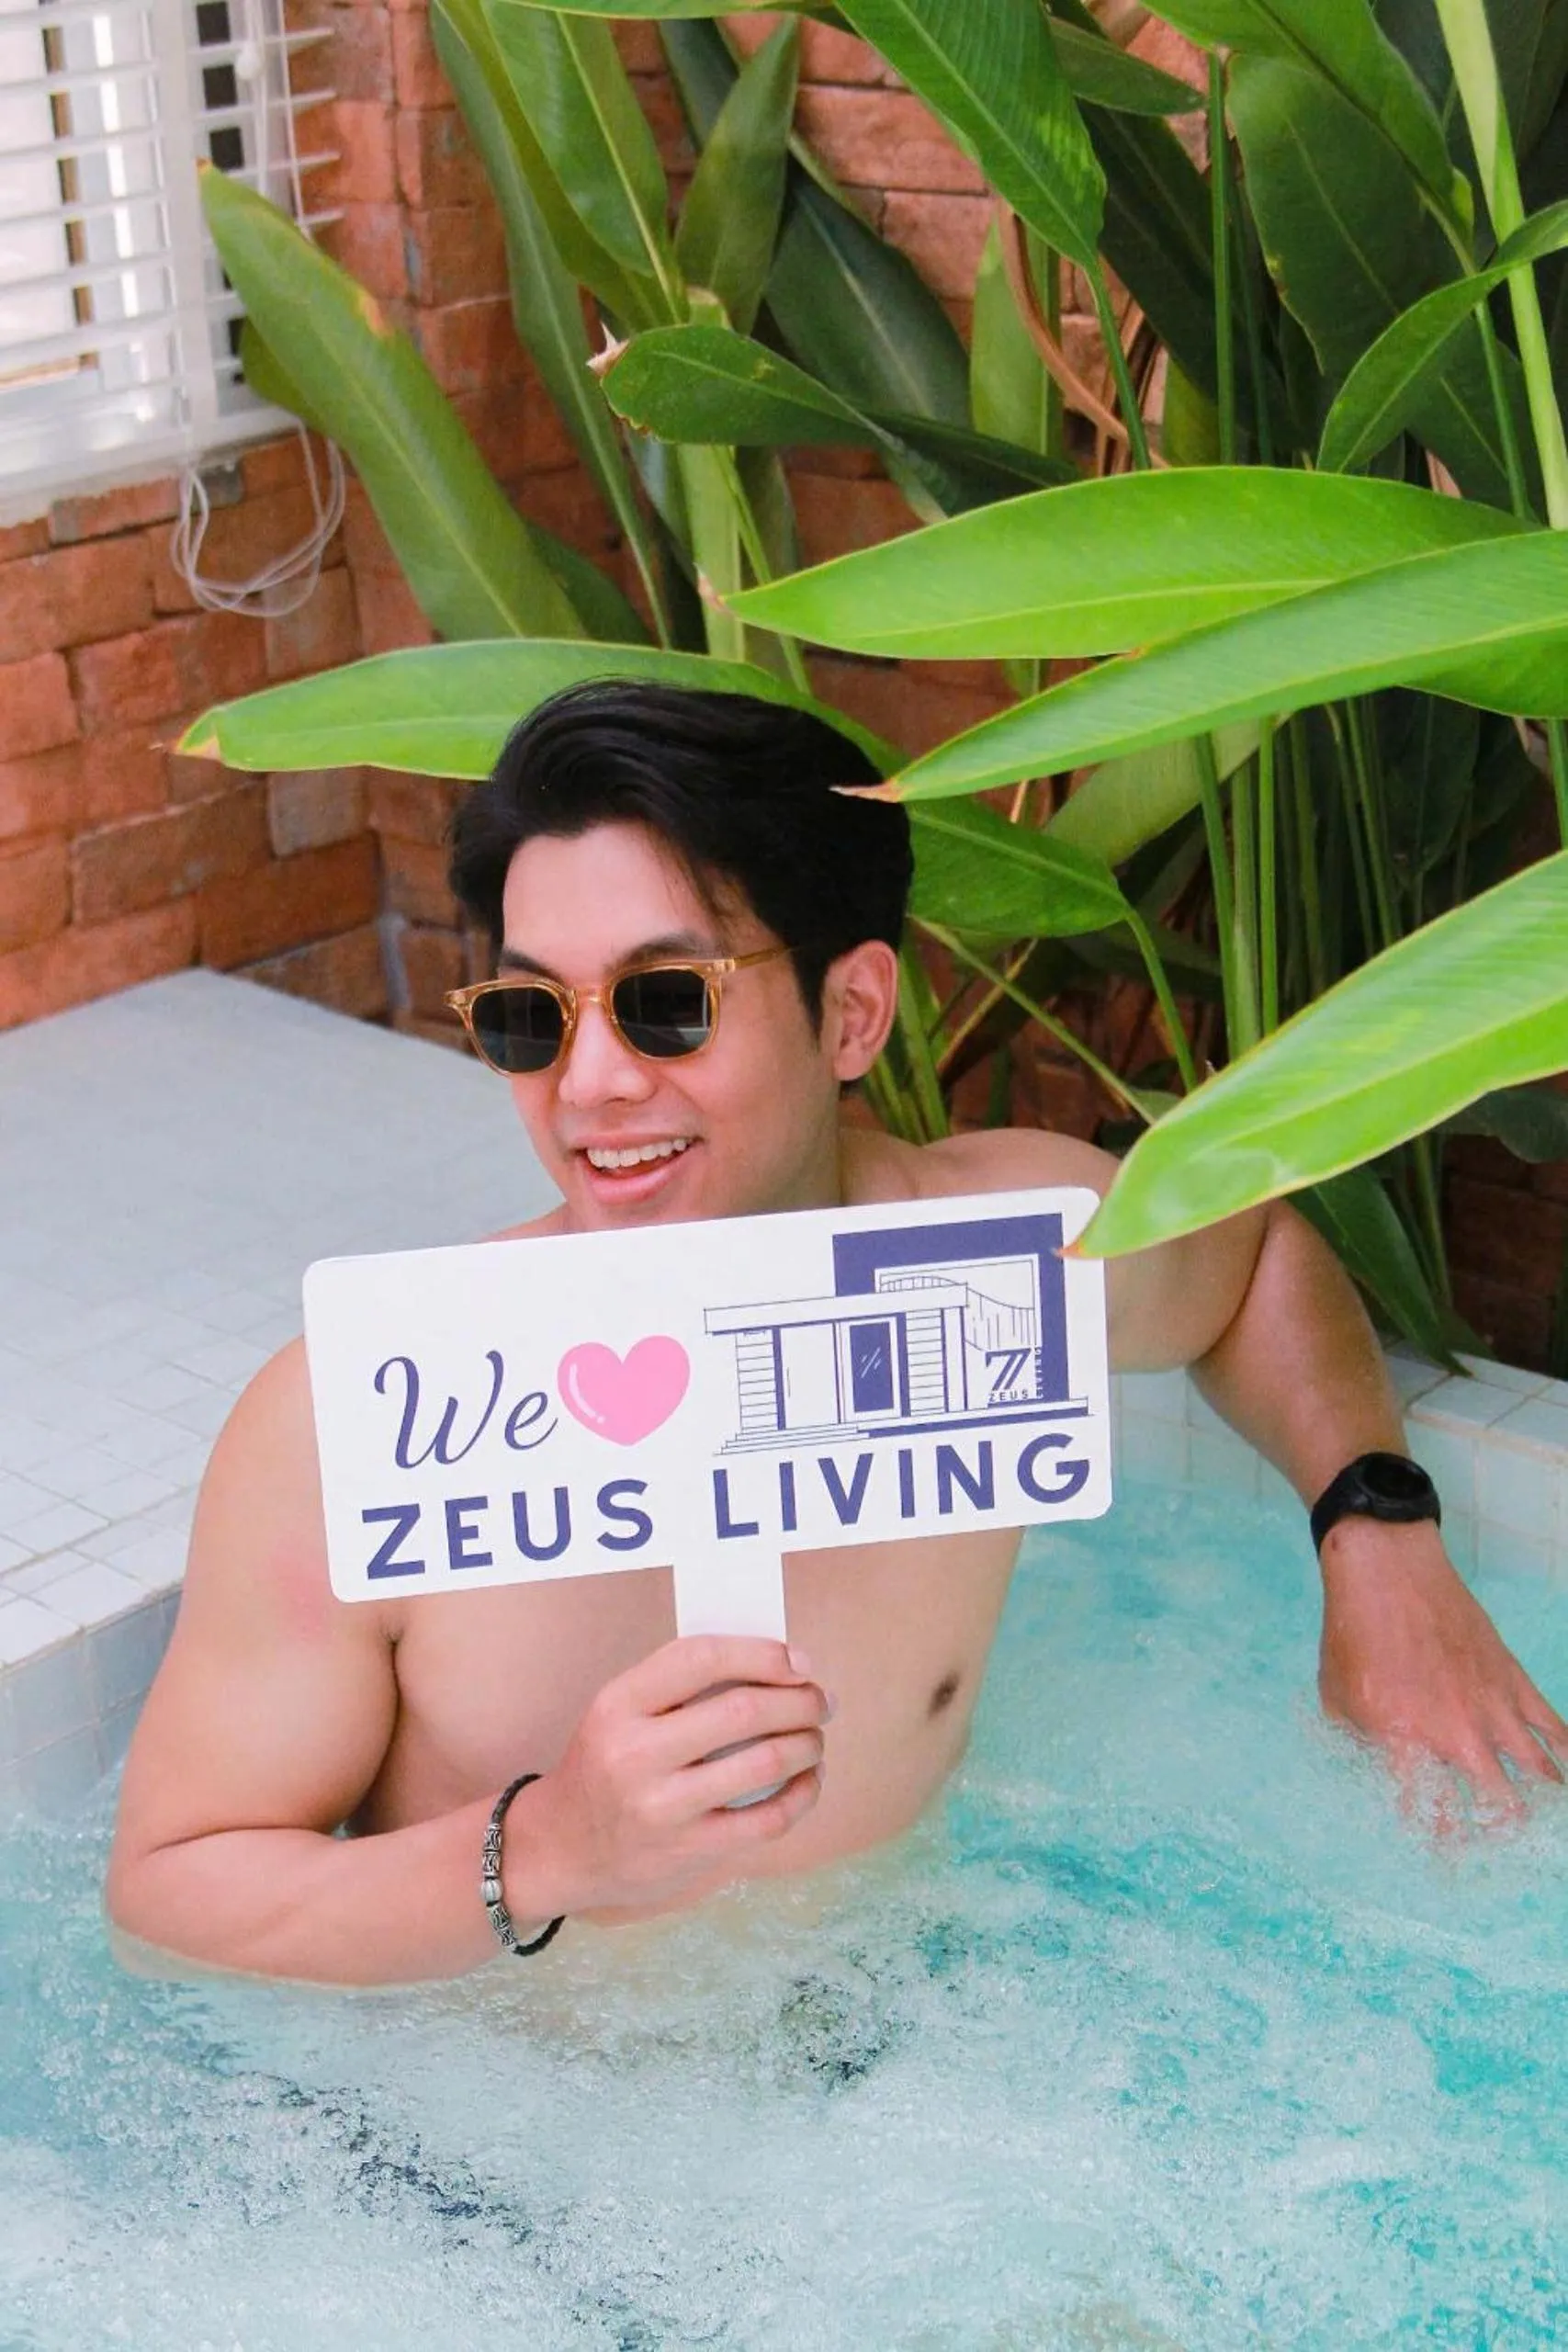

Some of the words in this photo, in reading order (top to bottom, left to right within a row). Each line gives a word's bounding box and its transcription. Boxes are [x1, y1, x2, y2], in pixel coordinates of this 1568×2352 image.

[374, 1350, 558, 1469] We
[989, 1389, 1029, 1401] ZEUS
[362, 1478, 653, 1580] ZEUS
[713, 1432, 1090, 1539] LIVING
